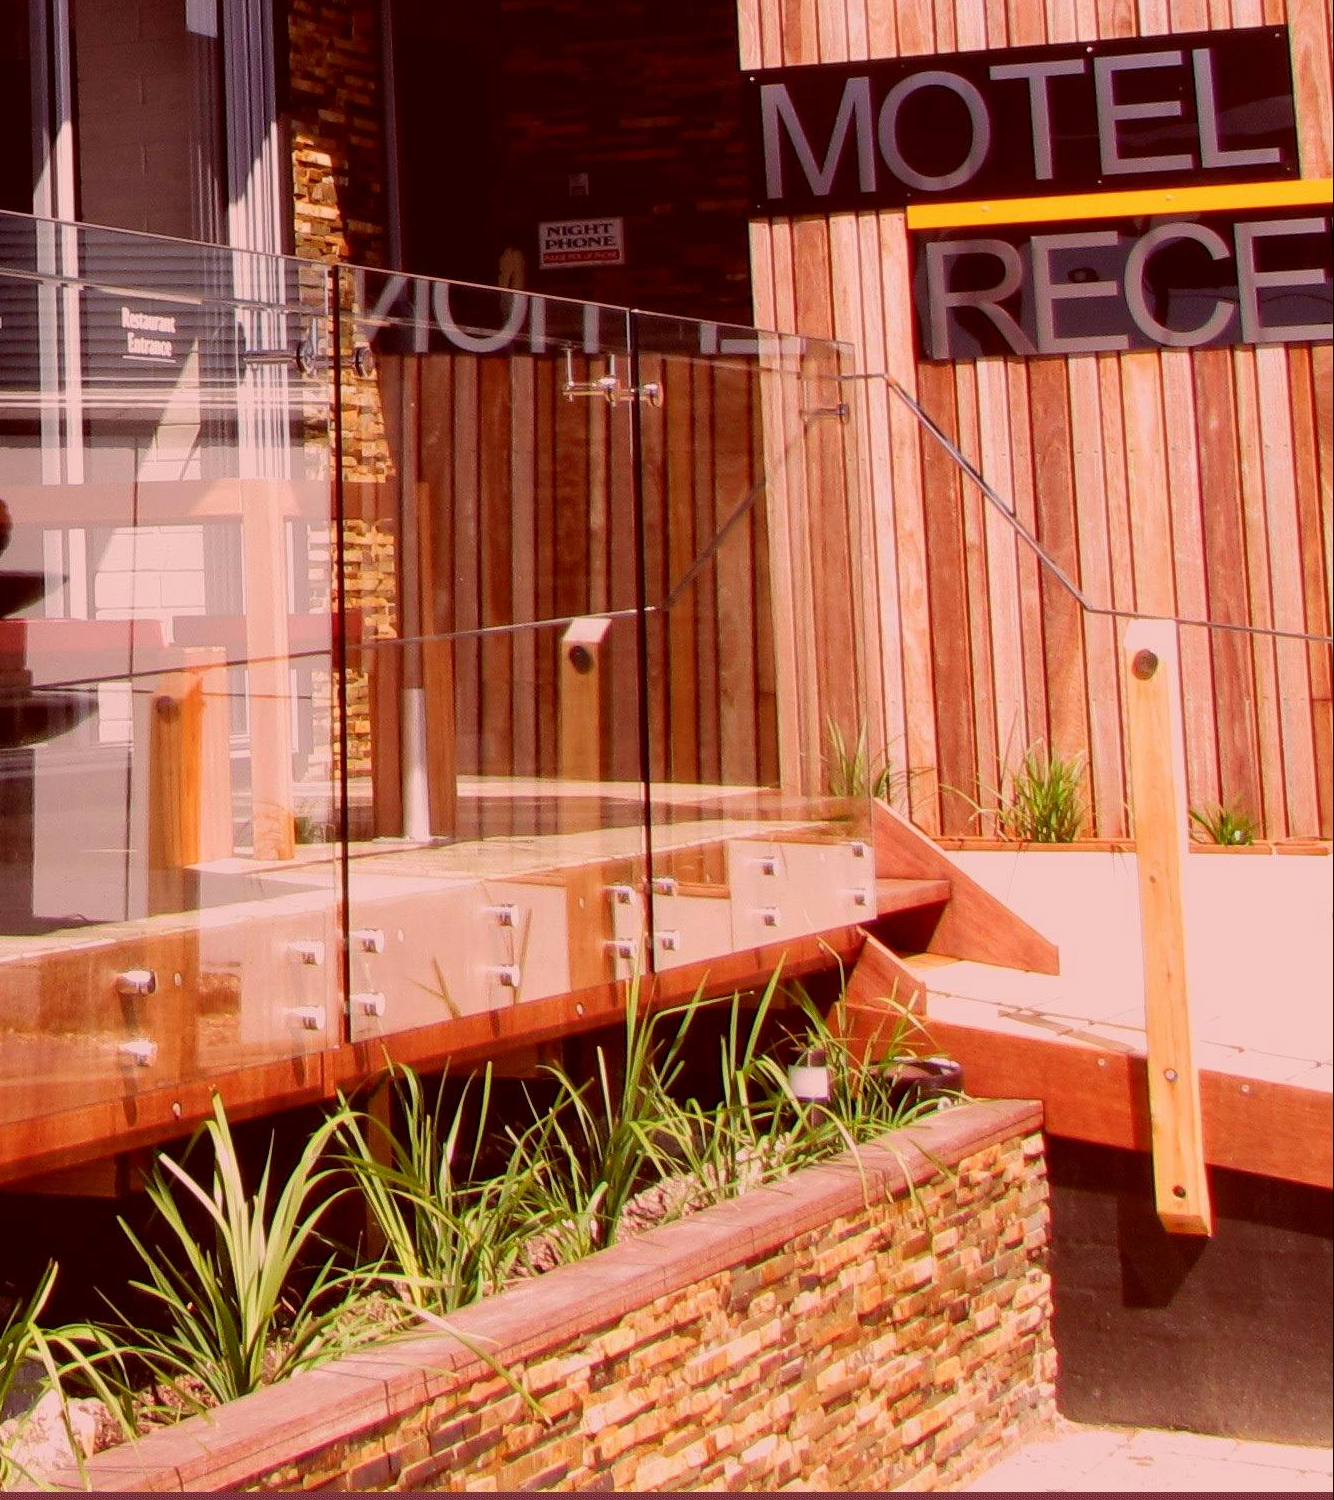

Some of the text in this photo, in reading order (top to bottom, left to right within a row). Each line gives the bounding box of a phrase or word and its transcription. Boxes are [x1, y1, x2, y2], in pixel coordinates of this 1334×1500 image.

[760, 48, 1281, 199] MOTEL
[545, 236, 615, 250] PHONE
[547, 223, 613, 237] NIGHT
[926, 217, 1333, 360] RECE
[121, 306, 176, 333] Restaurant
[127, 332, 173, 357] Entrance
